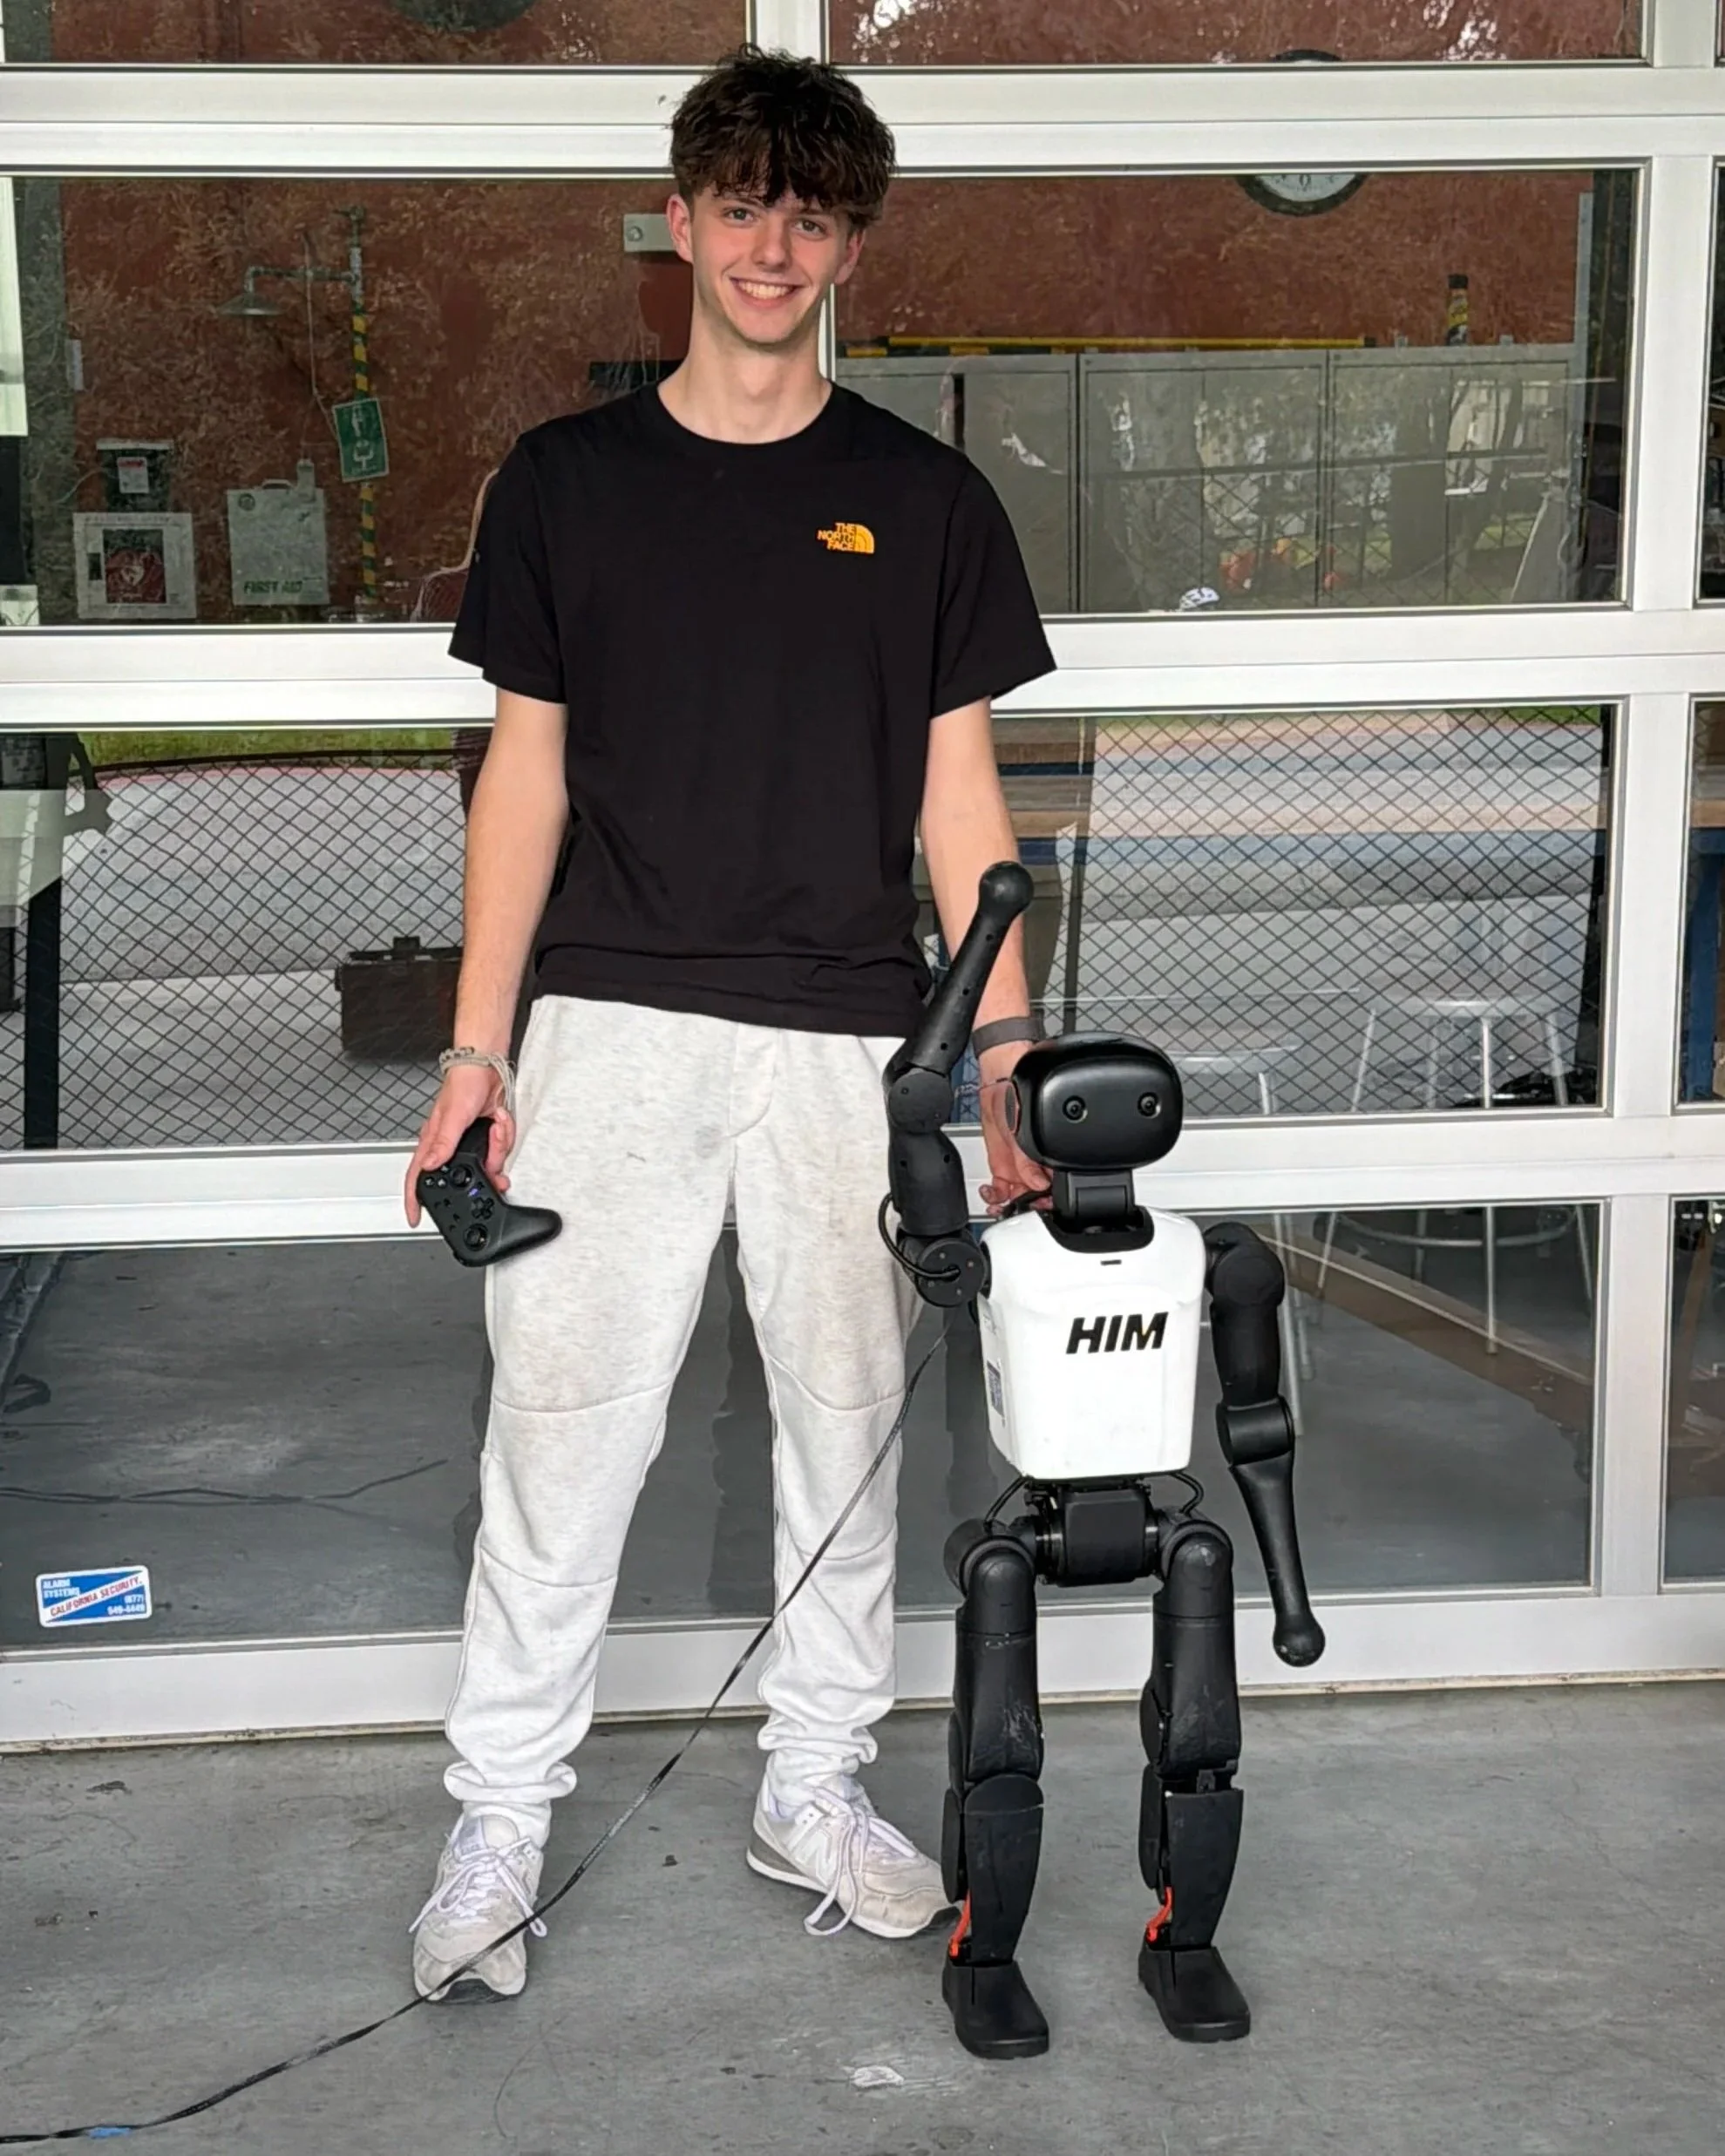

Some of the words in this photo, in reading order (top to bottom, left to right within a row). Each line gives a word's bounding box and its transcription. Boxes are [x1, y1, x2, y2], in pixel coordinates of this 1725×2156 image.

[835, 522, 856, 532] THE
[818, 530, 856, 542] NORTH
[826, 539, 856, 552] FACE
[244, 580, 278, 593] FIRST
[1065, 1312, 1169, 1354] HIM
[50, 1593, 98, 1617] CALIFORNIA
